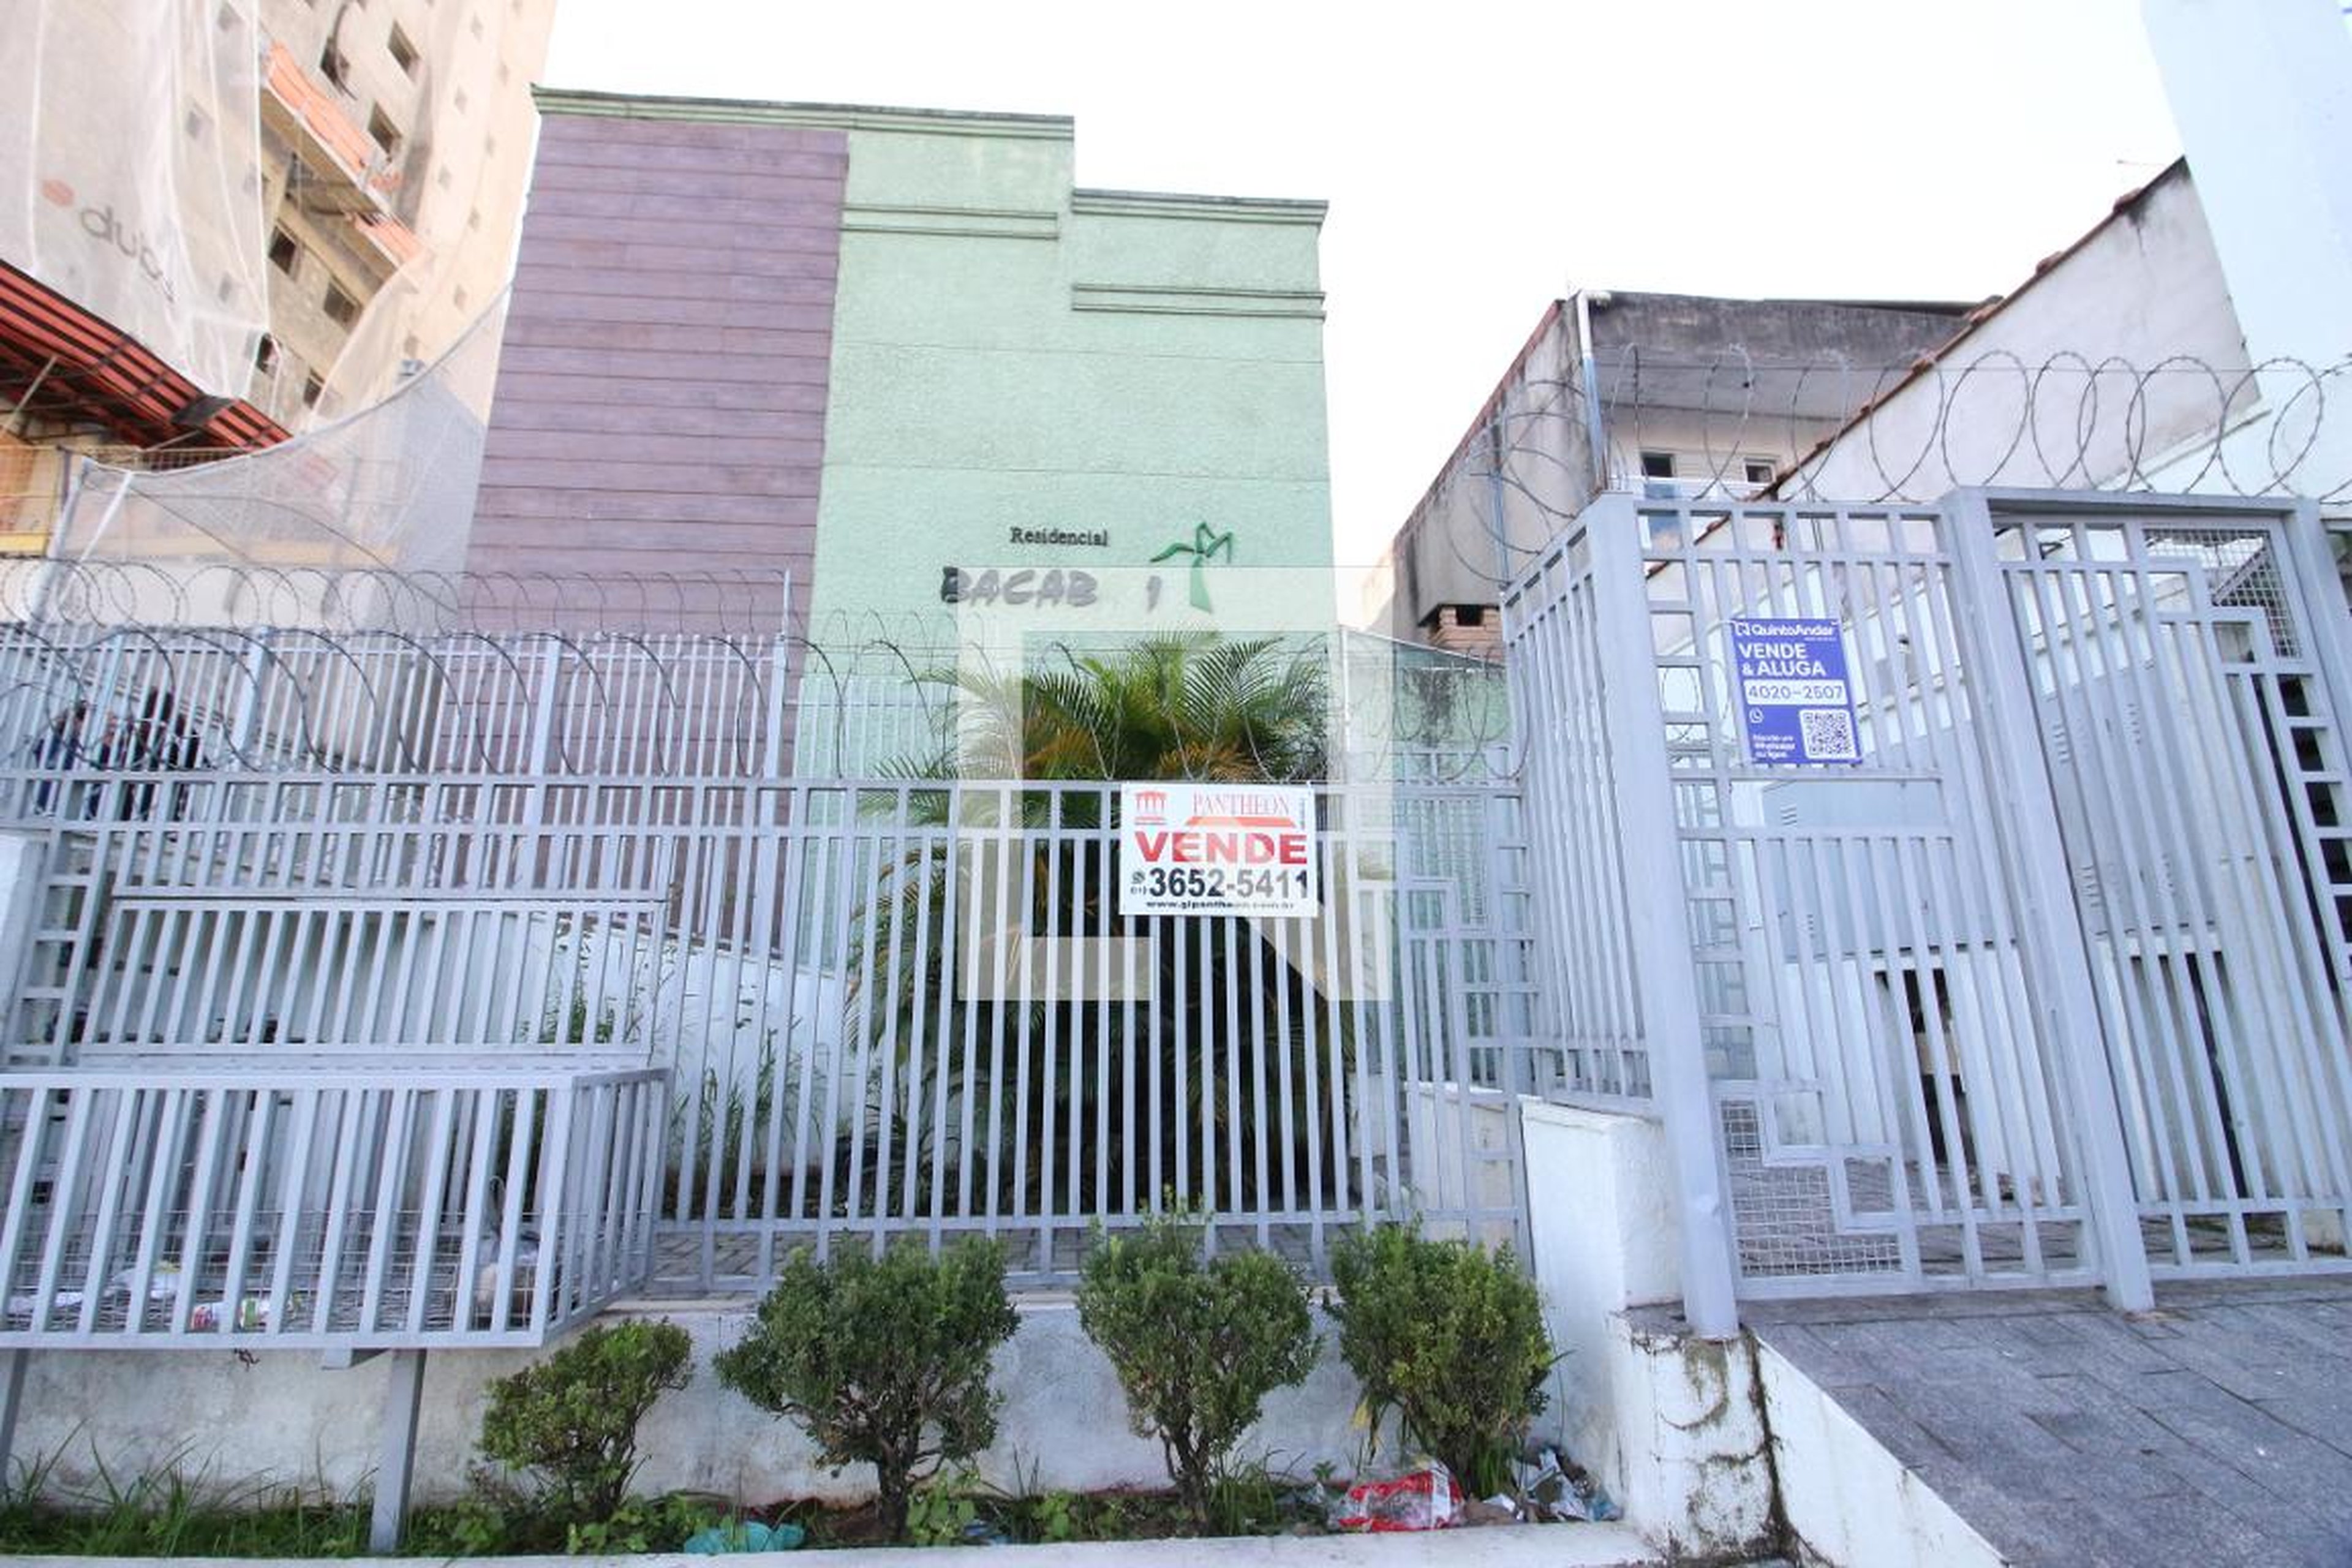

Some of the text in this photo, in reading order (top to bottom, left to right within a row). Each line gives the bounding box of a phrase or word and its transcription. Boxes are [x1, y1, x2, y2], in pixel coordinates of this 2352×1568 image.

[1009, 526, 1109, 546] Residencial
[941, 567, 1098, 607] BACAB
[1751, 624, 1833, 636] QuintoAndar
[1738, 644, 1807, 659] VENDE
[1741, 660, 1827, 676] & ALUGA
[1193, 793, 1290, 816] PANTHEON
[1135, 831, 1308, 864] VENDE
[1149, 867, 1308, 899] 3652-5411
